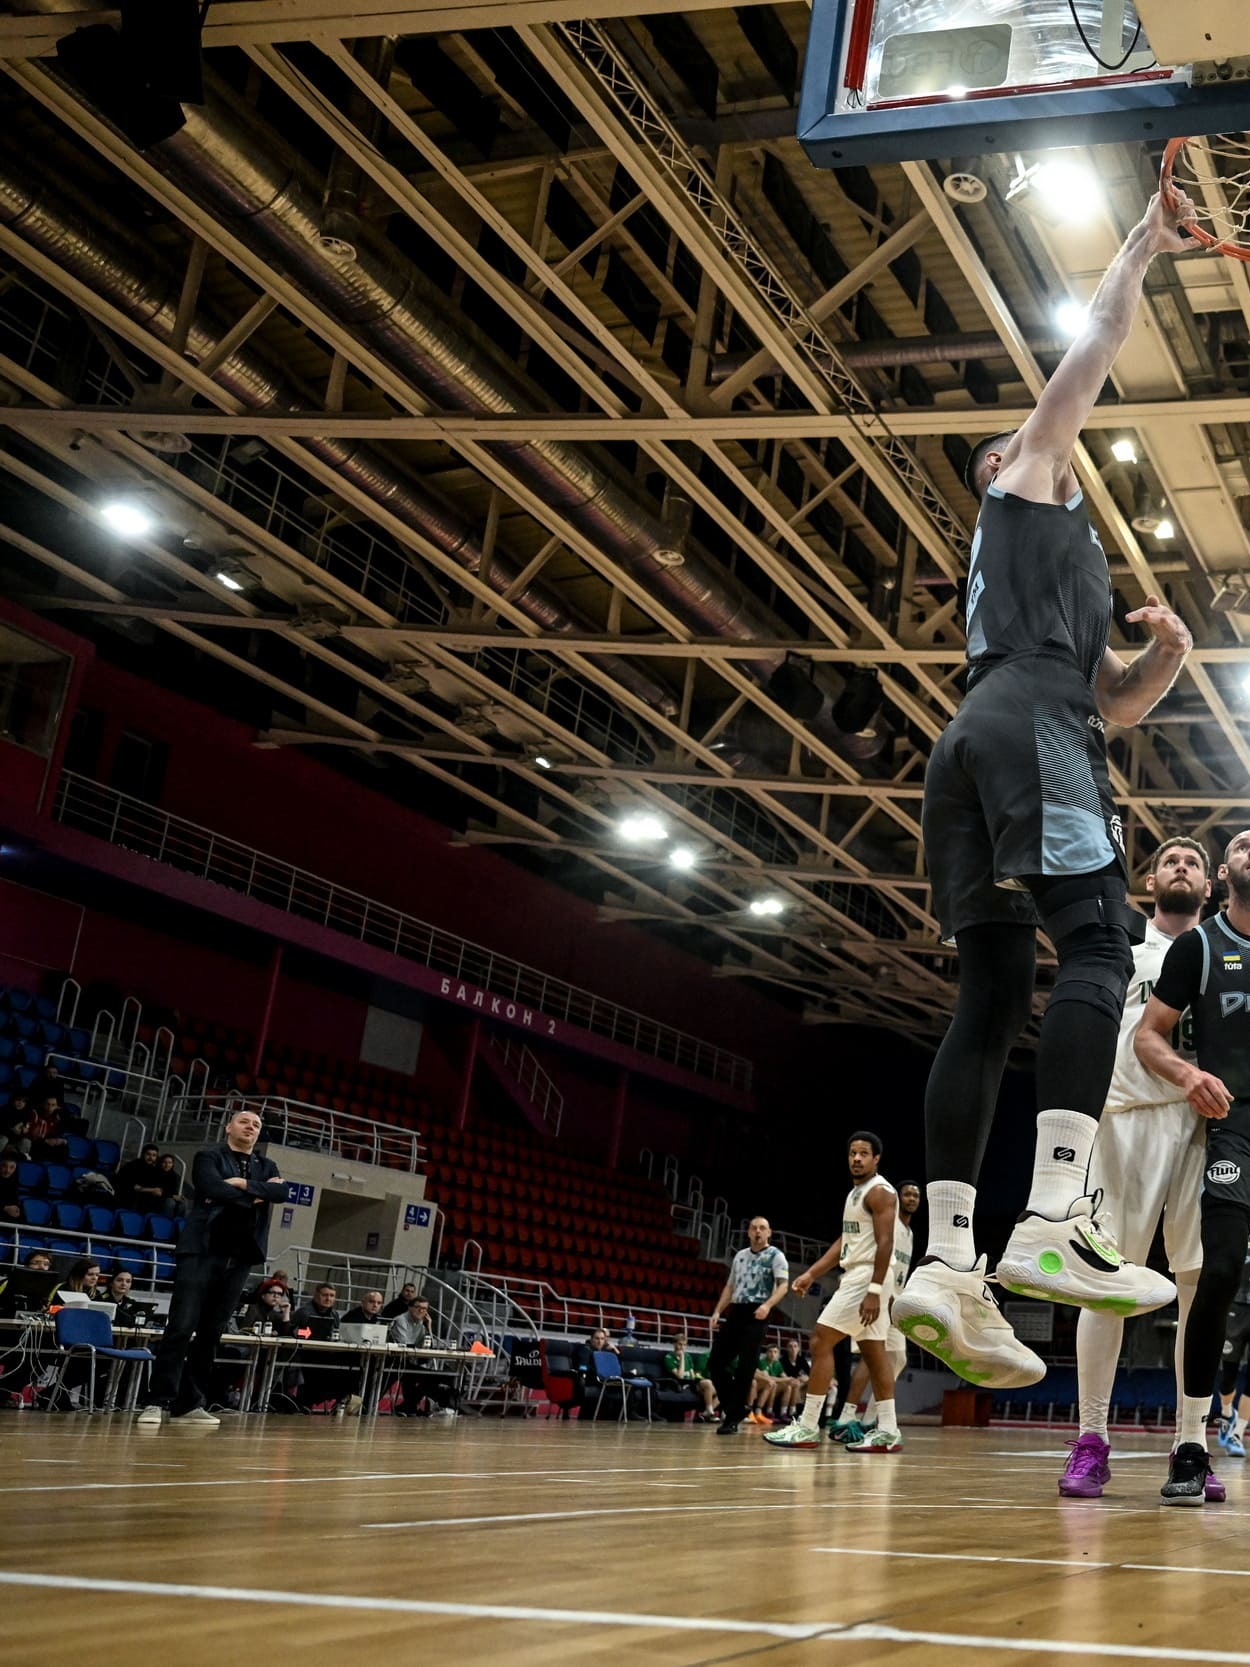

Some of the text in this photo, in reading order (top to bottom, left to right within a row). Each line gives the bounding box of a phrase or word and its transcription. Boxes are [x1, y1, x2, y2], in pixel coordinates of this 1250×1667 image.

[441, 978, 556, 1034] БАЛКОН 2
[303, 1186, 311, 1197] 3
[409, 1206, 415, 1217] 4
